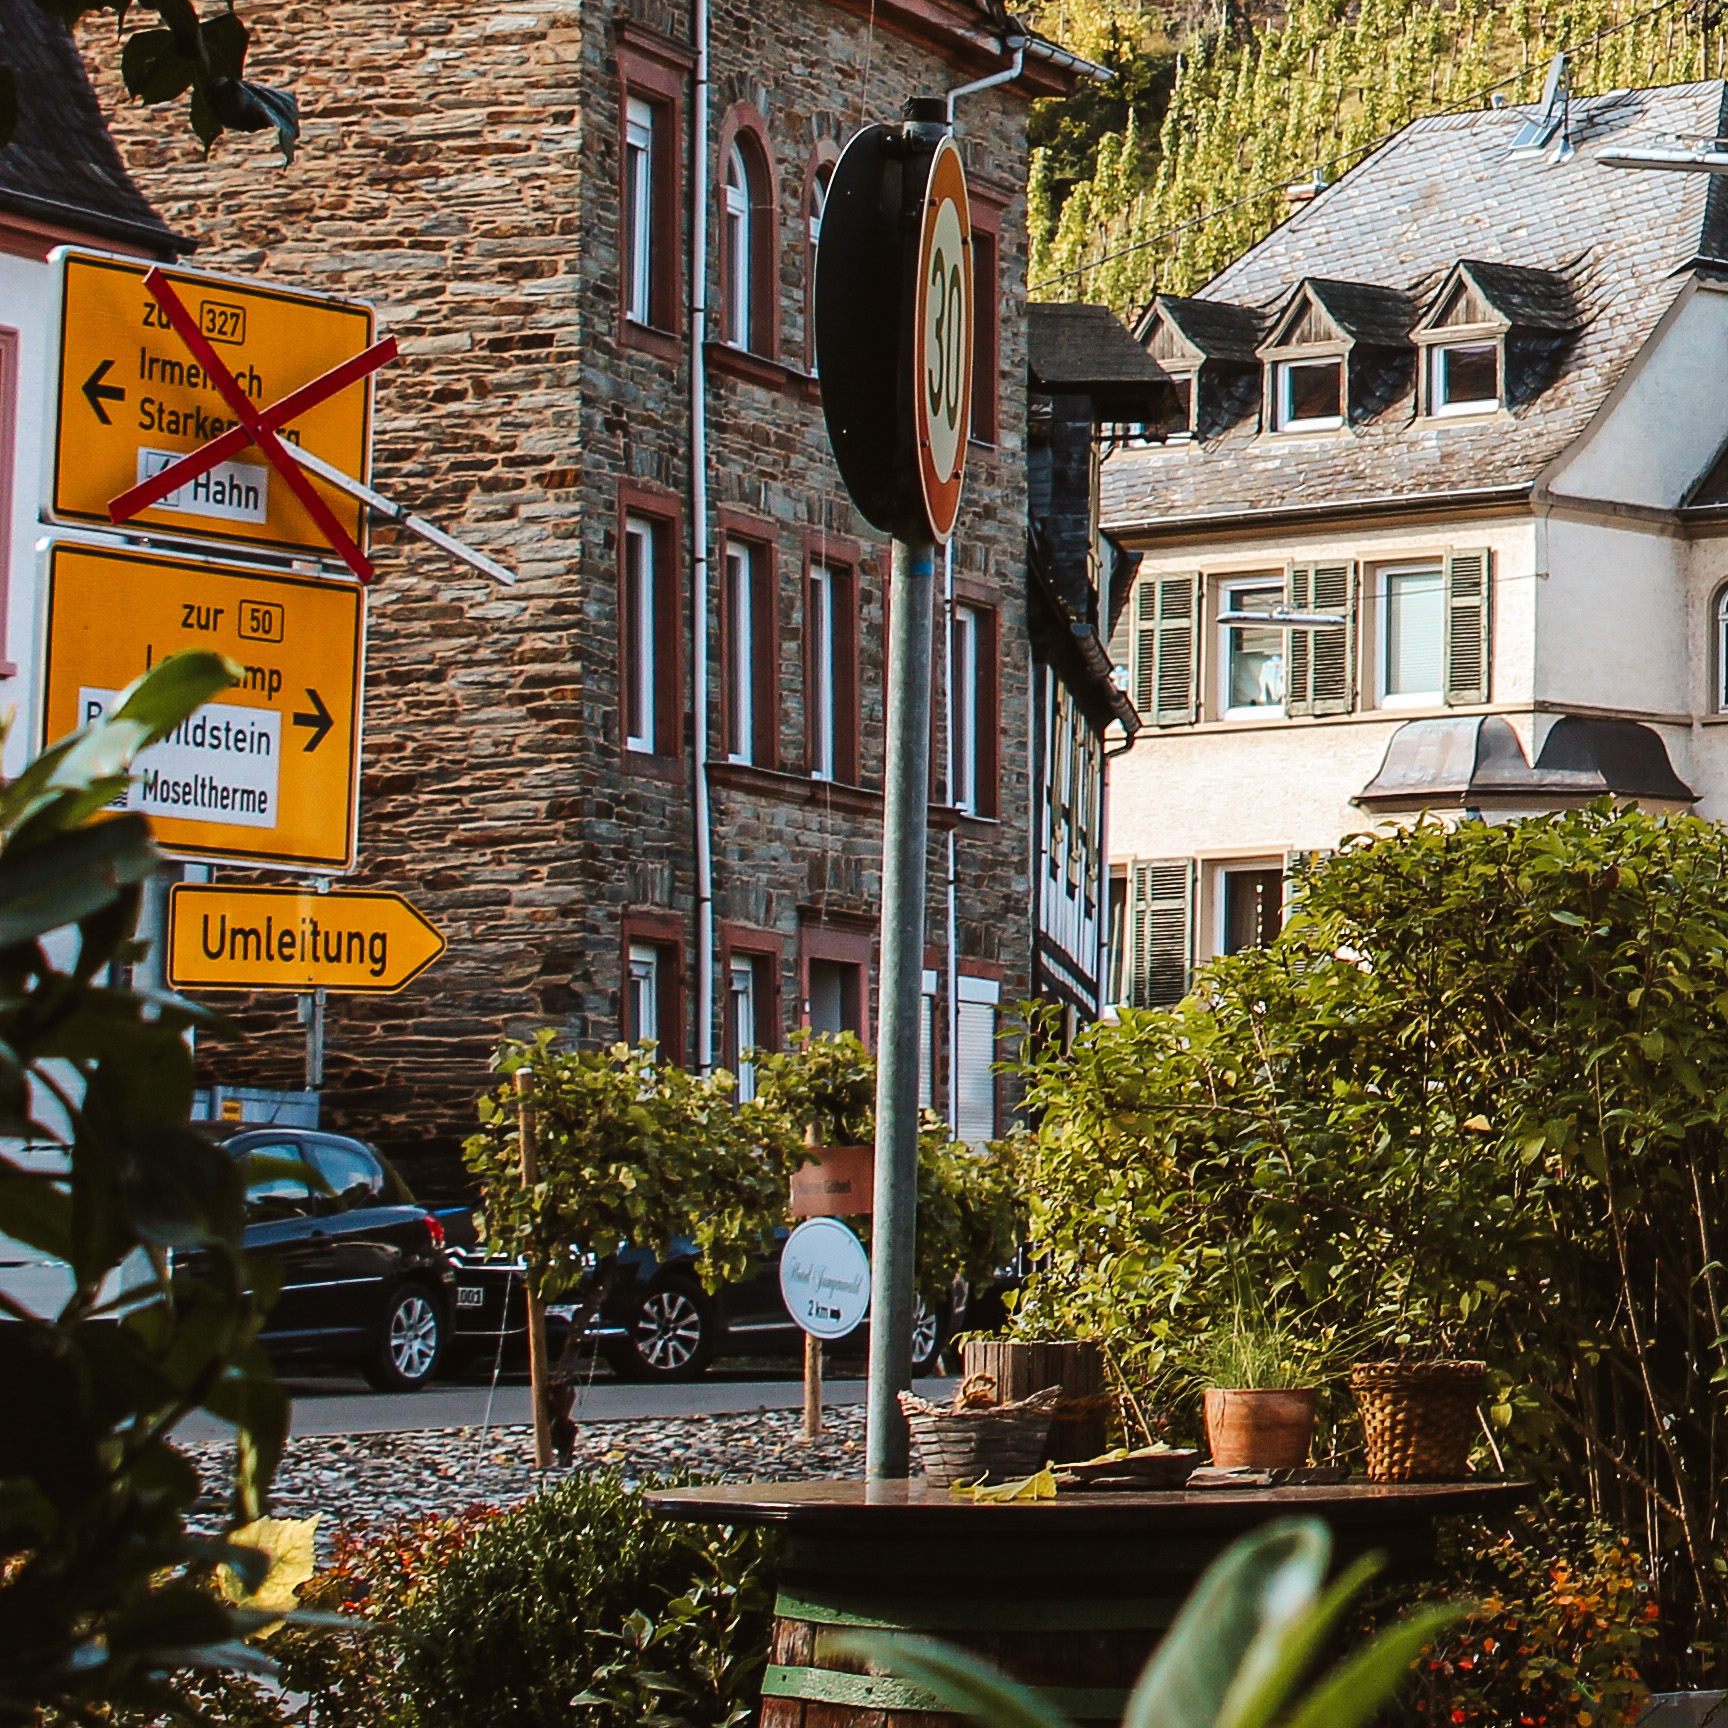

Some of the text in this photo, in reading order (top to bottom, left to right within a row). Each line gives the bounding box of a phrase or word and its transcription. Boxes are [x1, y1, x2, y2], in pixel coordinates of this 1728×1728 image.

[142, 301, 241, 338] zu 327
[927, 246, 963, 432] 30
[193, 471, 259, 511] Hahn
[181, 603, 273, 635] zur 50
[141, 768, 269, 814] Moseltherme
[202, 913, 388, 977] Umleitung
[807, 1299, 829, 1319] 2 km
